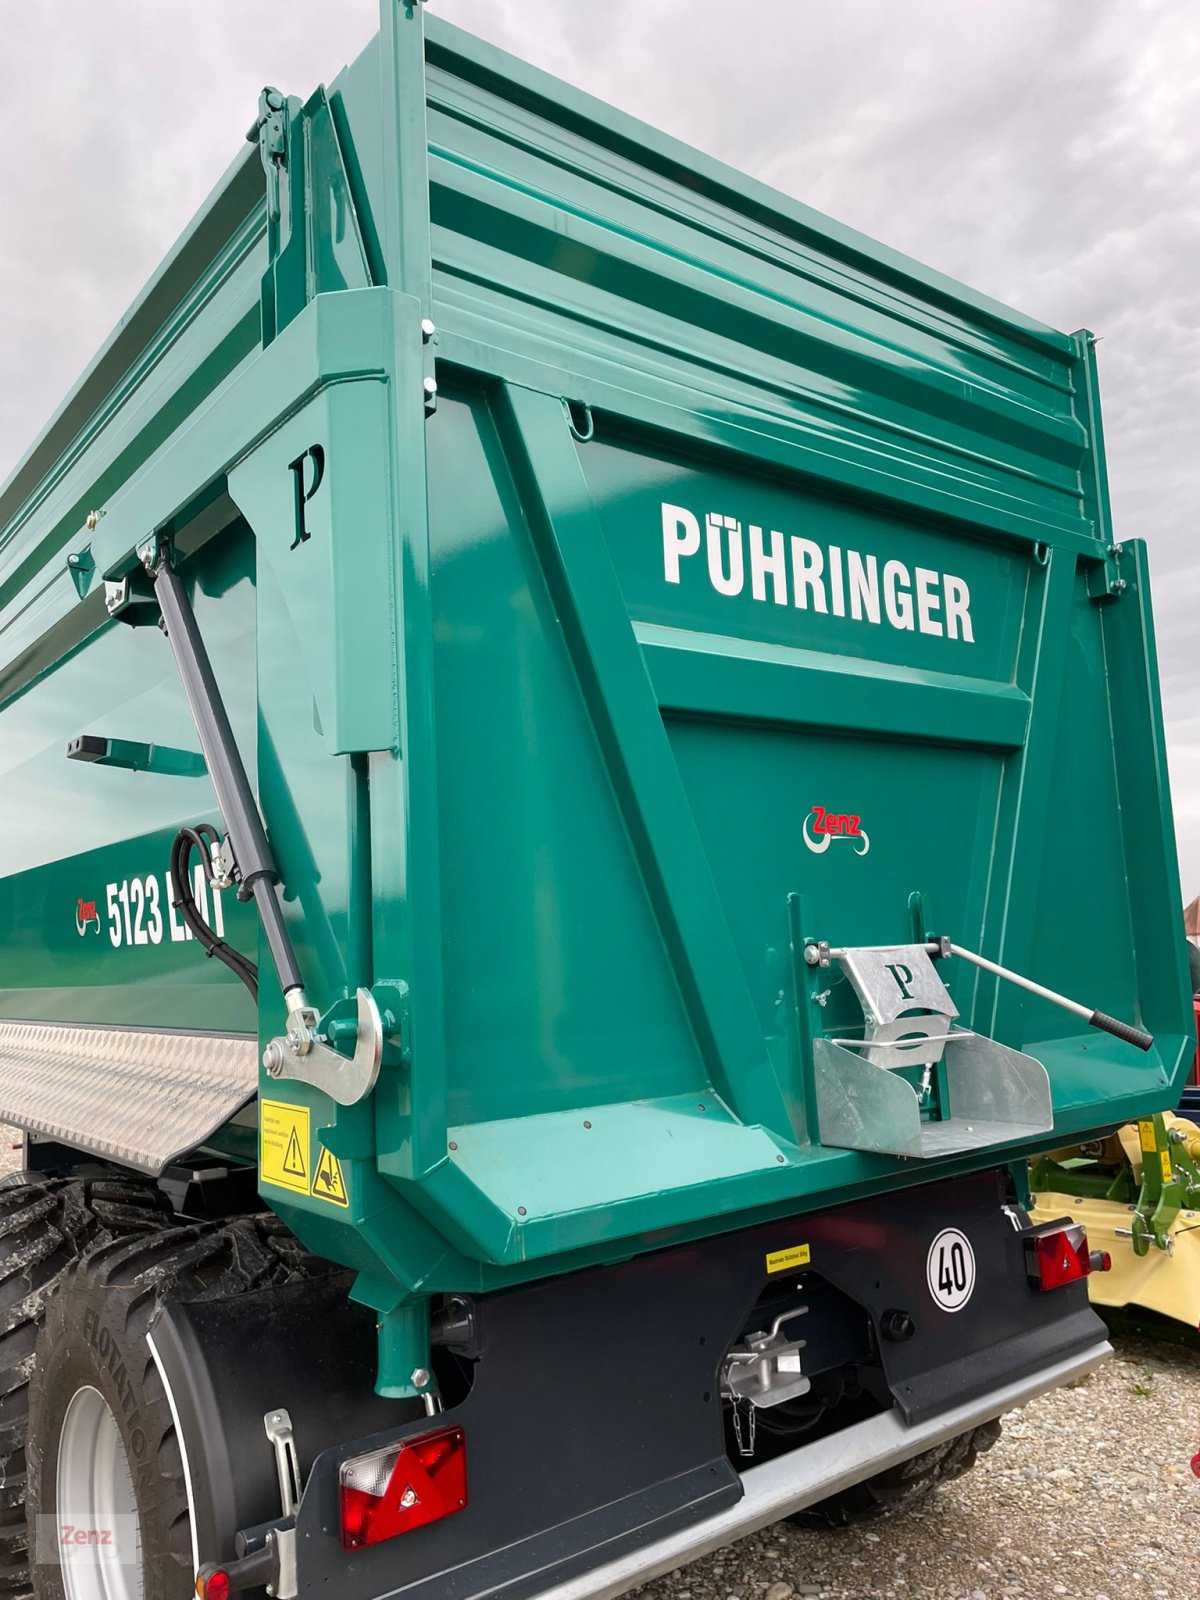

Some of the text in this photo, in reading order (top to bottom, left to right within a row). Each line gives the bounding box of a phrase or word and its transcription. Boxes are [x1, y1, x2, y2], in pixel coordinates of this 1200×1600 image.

[288, 443, 325, 551] P
[661, 502, 975, 643] PÜHRINGER
[811, 806, 861, 836] Zenz
[106, 874, 163, 948] 5123
[884, 963, 915, 1000] P
[938, 1242, 967, 1296] 40
